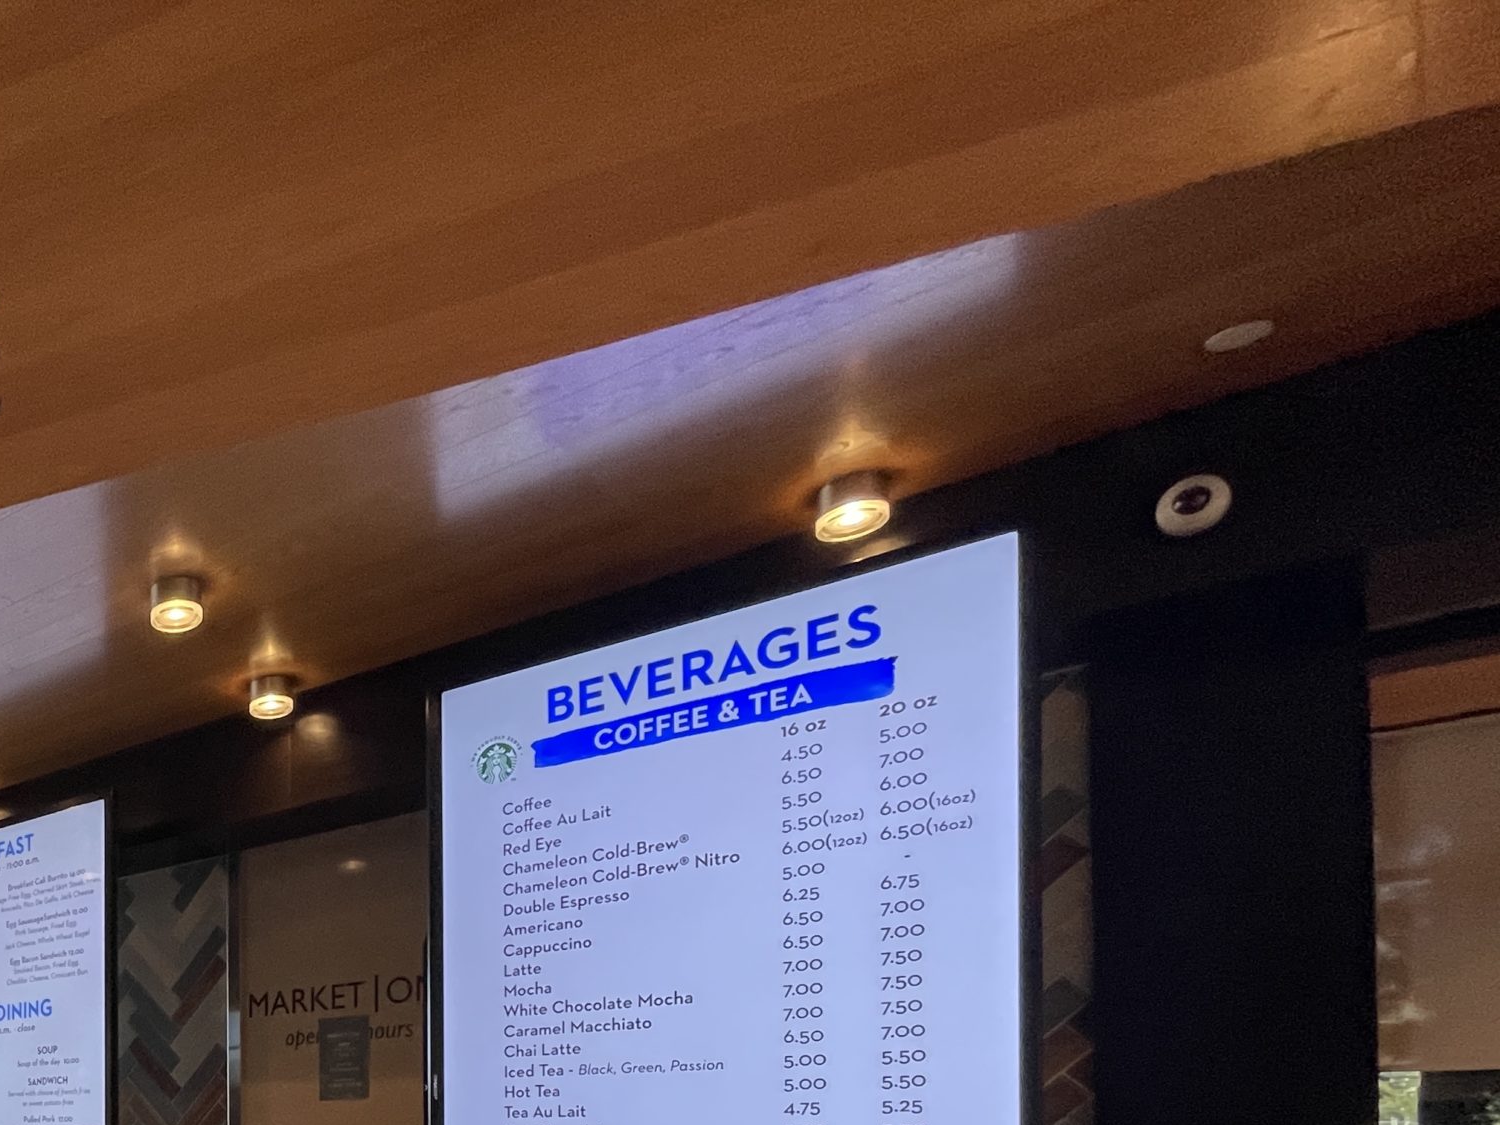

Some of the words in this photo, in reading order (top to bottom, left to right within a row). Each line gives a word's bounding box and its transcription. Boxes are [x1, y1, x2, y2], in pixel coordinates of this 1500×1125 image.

[546, 603, 882, 725] BEVERAGES
[593, 704, 709, 749] COFFEE
[717, 699, 739, 723] &
[748, 683, 813, 715] TEA
[878, 700, 907, 718] 20
[913, 694, 938, 710] oz
[780, 721, 800, 738] 16
[804, 718, 827, 733] oz
[878, 721, 928, 744] 5.00
[780, 742, 823, 762] 4.50
[879, 746, 925, 769] 7.00
[780, 766, 822, 785] 6.50
[501, 795, 552, 816] Coffee
[501, 816, 553, 836] Coffee
[555, 812, 577, 827] Au
[581, 804, 611, 822] Lait
[502, 837, 531, 857] Red
[534, 836, 563, 853] Eye
[501, 853, 588, 877] Chameleon
[501, 874, 588, 897] Chameleon
[694, 852, 741, 869] Nitro
[879, 873, 920, 891] 6.75
[502, 897, 556, 917] Double
[559, 890, 630, 911] Espresso
[781, 885, 820, 903] 6.25
[502, 918, 584, 937] Americano
[502, 936, 592, 959] Cappuccino
[503, 962, 542, 978] Latte
[503, 980, 552, 998] Mocha
[502, 1002, 548, 1017] White
[551, 995, 633, 1015] Chocolate
[637, 989, 693, 1008] Mocha
[503, 1019, 566, 1039] Caramel
[569, 1016, 653, 1034] Macchiato
[35, 1043, 59, 1056] SOUP
[285, 1028, 319, 1050] ope
[503, 1042, 537, 1058] Chai
[540, 1042, 582, 1057] Latte
[503, 1062, 535, 1079] Iced
[538, 1062, 565, 1077] Tea
[577, 1061, 617, 1076] Black,
[620, 1060, 666, 1074] Green,
[669, 1058, 724, 1072] Passion
[26, 1074, 69, 1087] SANDWICH
[503, 1084, 531, 1099] Hot
[533, 1083, 561, 1098] Tea
[503, 1104, 529, 1119] Tea
[532, 1104, 553, 1119] Au
[556, 1103, 587, 1118] Lait
[782, 1101, 821, 1116] 4.75
[880, 1099, 923, 1115] 5.25
